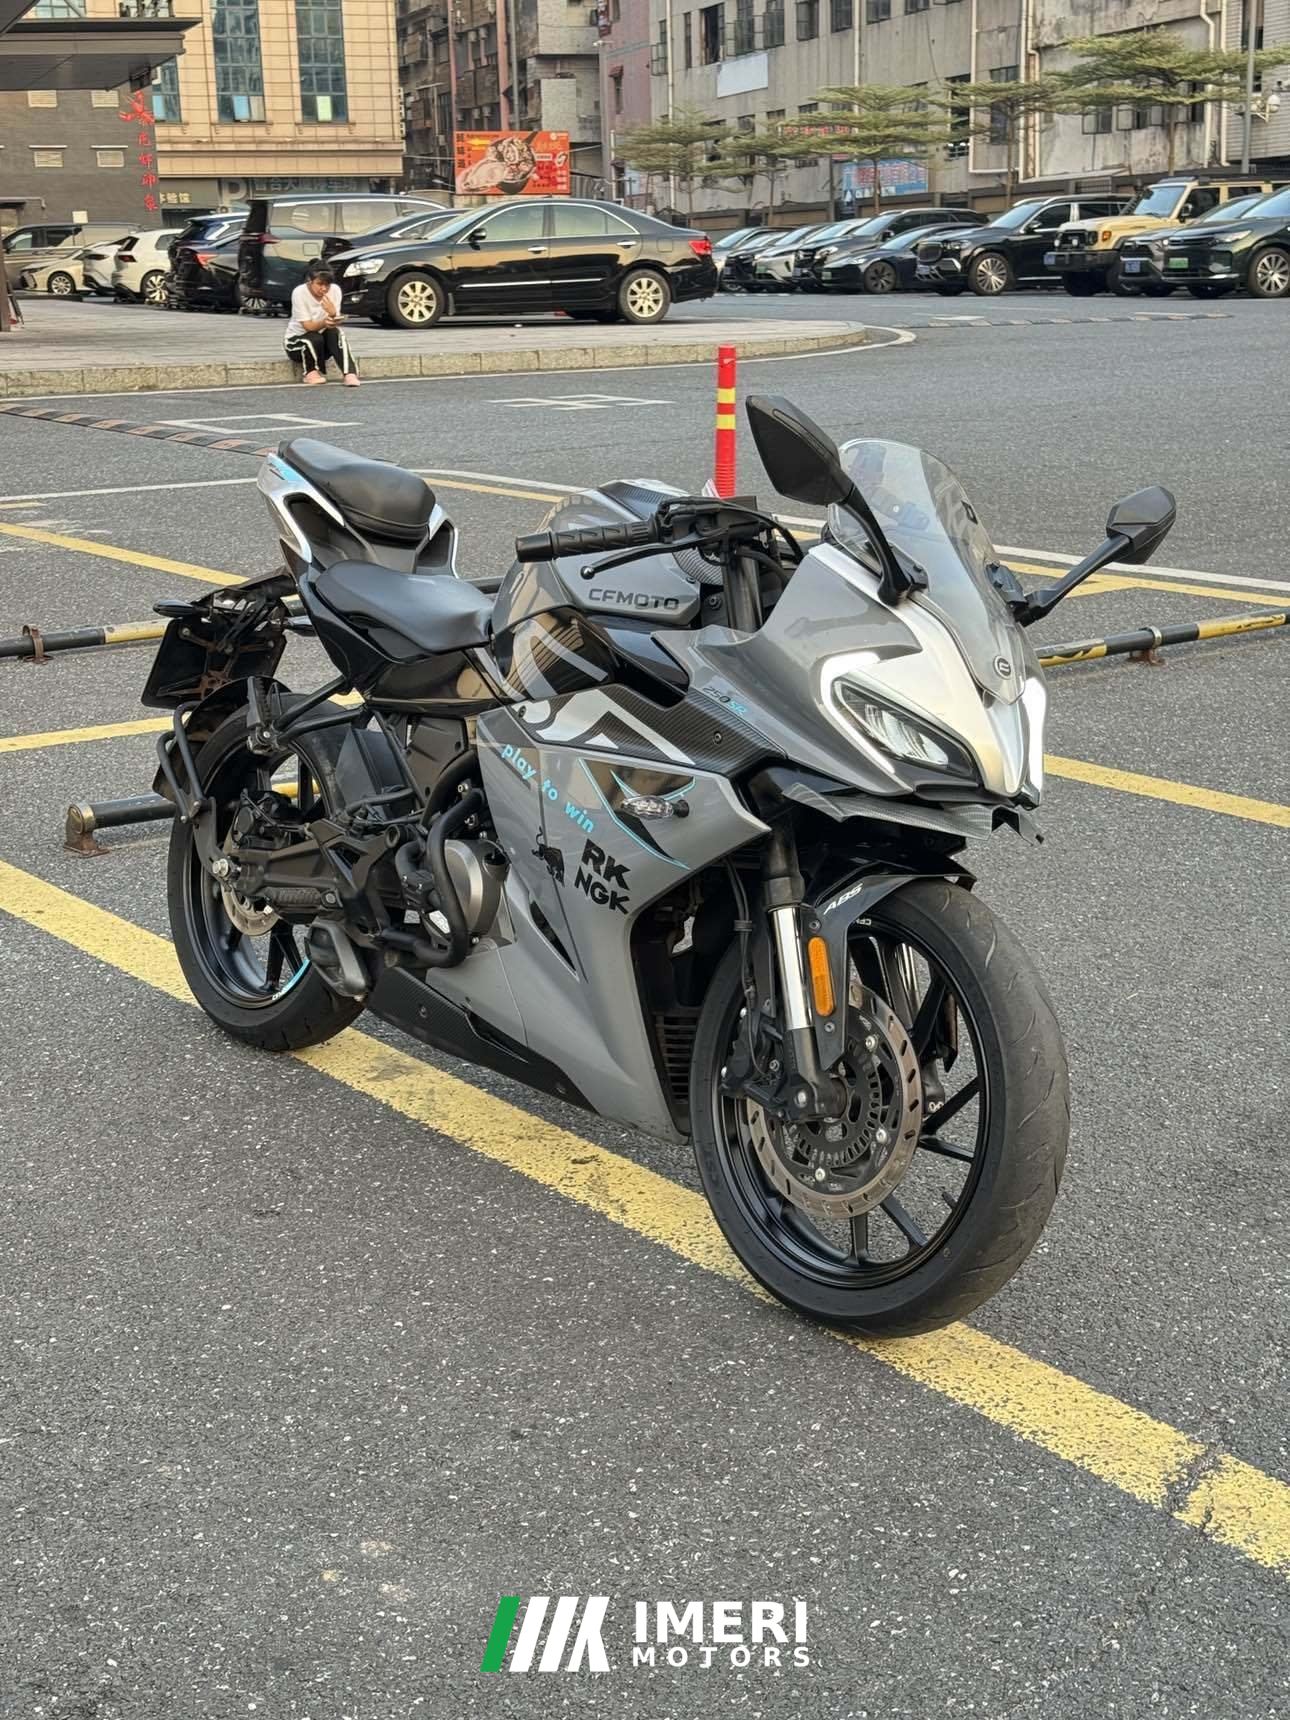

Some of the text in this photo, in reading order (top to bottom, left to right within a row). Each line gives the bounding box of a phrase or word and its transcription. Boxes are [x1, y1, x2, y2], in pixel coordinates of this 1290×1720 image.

[588, 587, 680, 611] CFMOTO
[501, 743, 596, 834] play to win
[581, 838, 631, 891] RK
[574, 865, 629, 915] NGK
[823, 882, 864, 916] ABS
